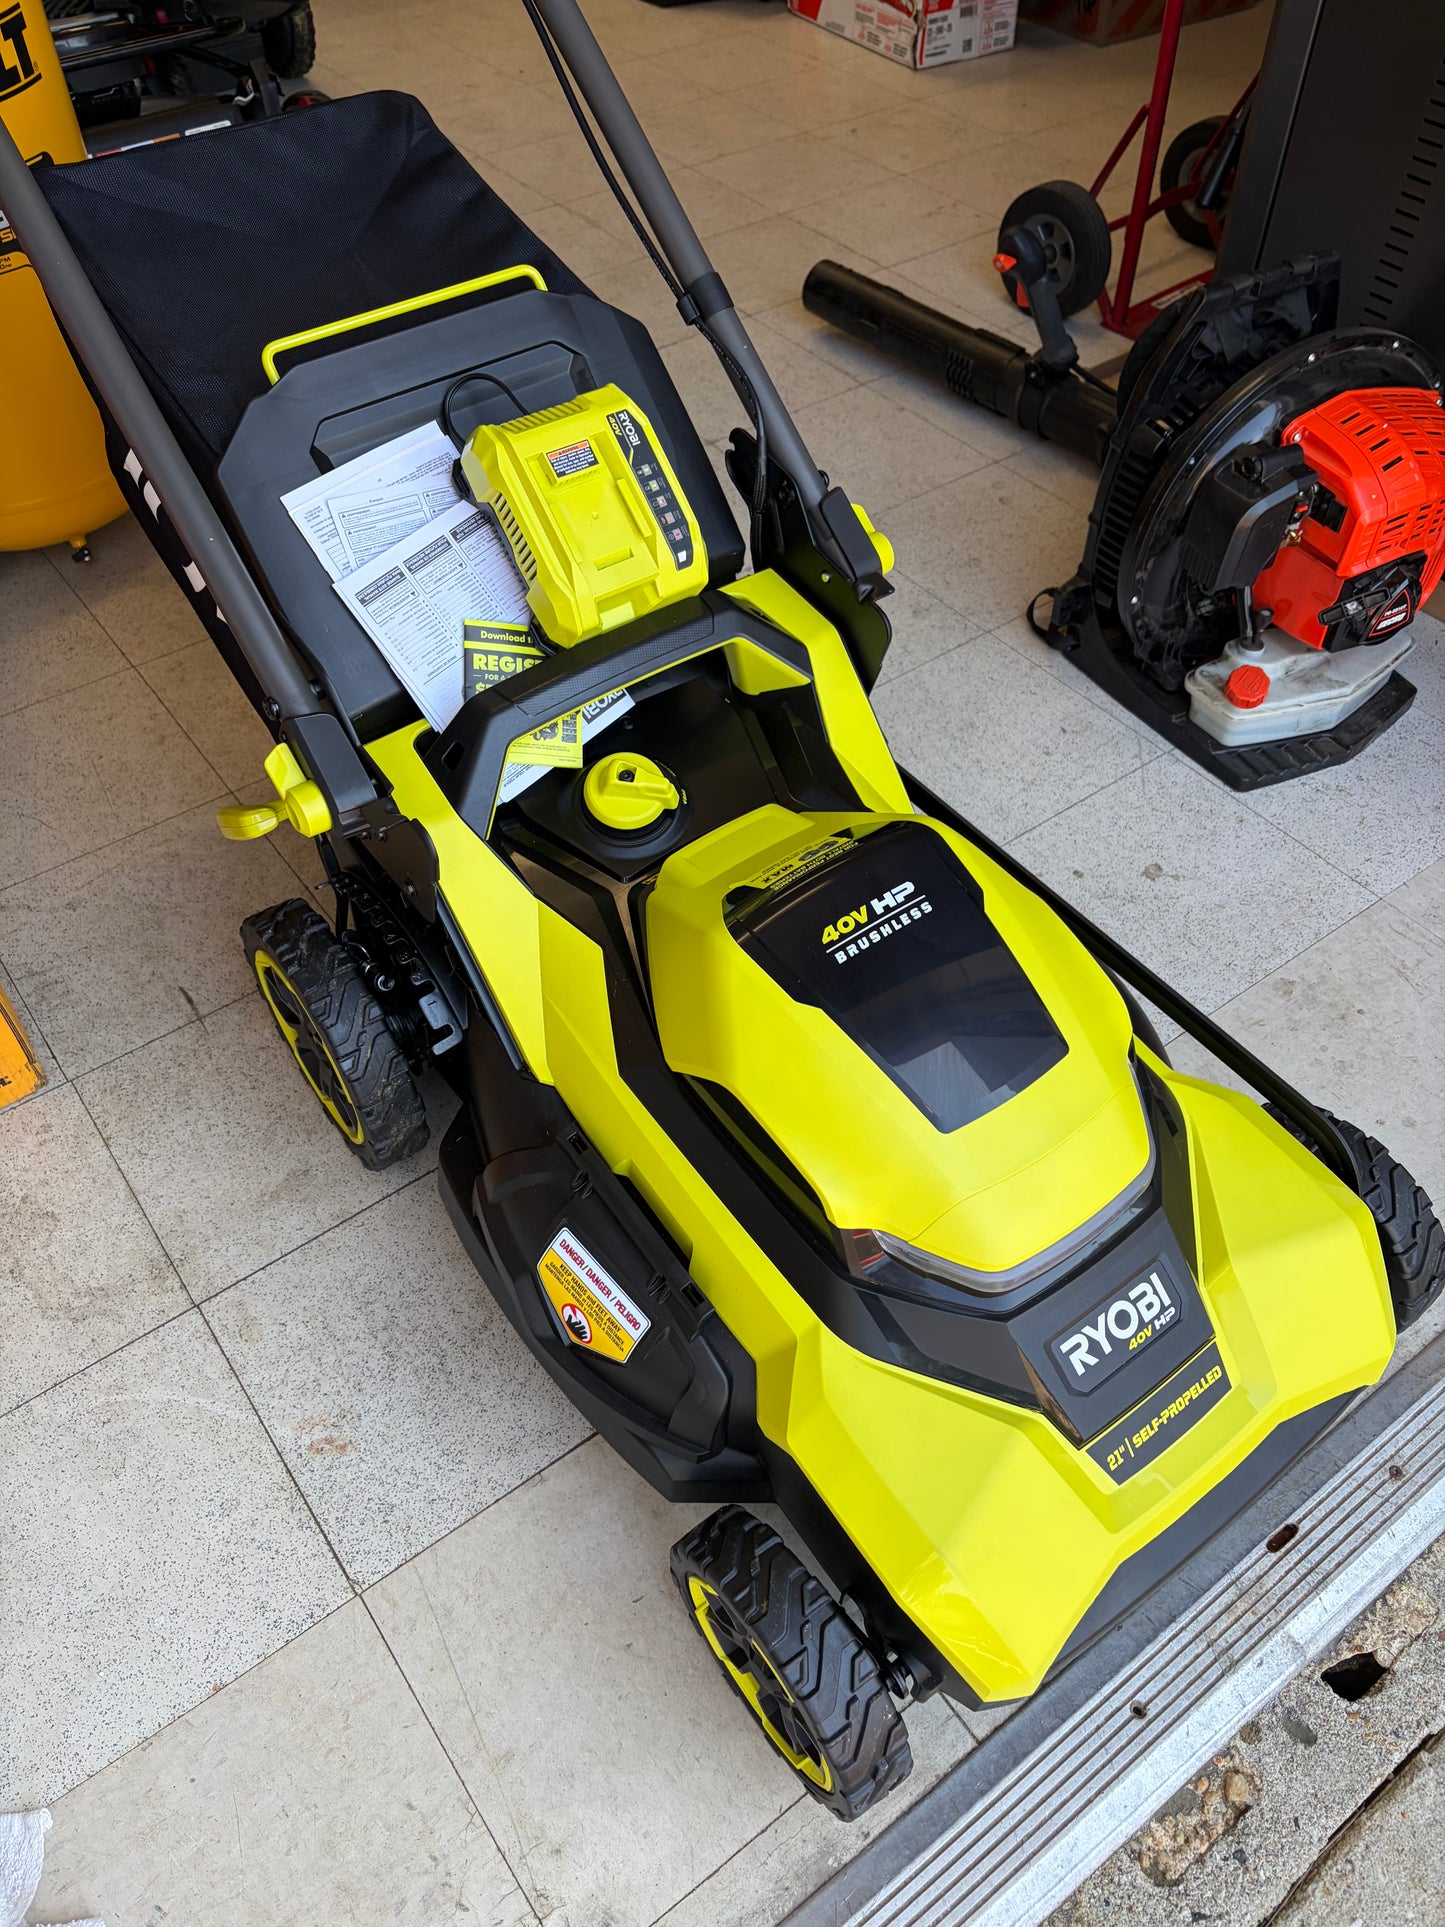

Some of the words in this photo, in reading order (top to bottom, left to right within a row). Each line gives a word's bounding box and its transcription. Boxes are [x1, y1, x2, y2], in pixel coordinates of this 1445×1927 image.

[609, 416, 622, 436] 40V
[618, 411, 641, 446] RYOBI
[480, 630, 525, 643] Download
[821, 905, 868, 945] 40V
[870, 881, 915, 915] HP
[834, 901, 933, 964] BRUSHLESS
[558, 1239, 586, 1268] DANGER
[584, 1268, 613, 1298] DANGER
[614, 1300, 641, 1331] PELIGRO
[558, 1263, 572, 1278] KEEP
[570, 1276, 588, 1295] HANDS
[594, 1303, 608, 1317] FEET
[606, 1316, 621, 1332] AWAY
[1059, 1271, 1172, 1376] RYOBI
[1128, 1324, 1153, 1351] 40V
[1155, 1306, 1176, 1331] HP
[1132, 1365, 1223, 1448] SELF-PROPELLED
